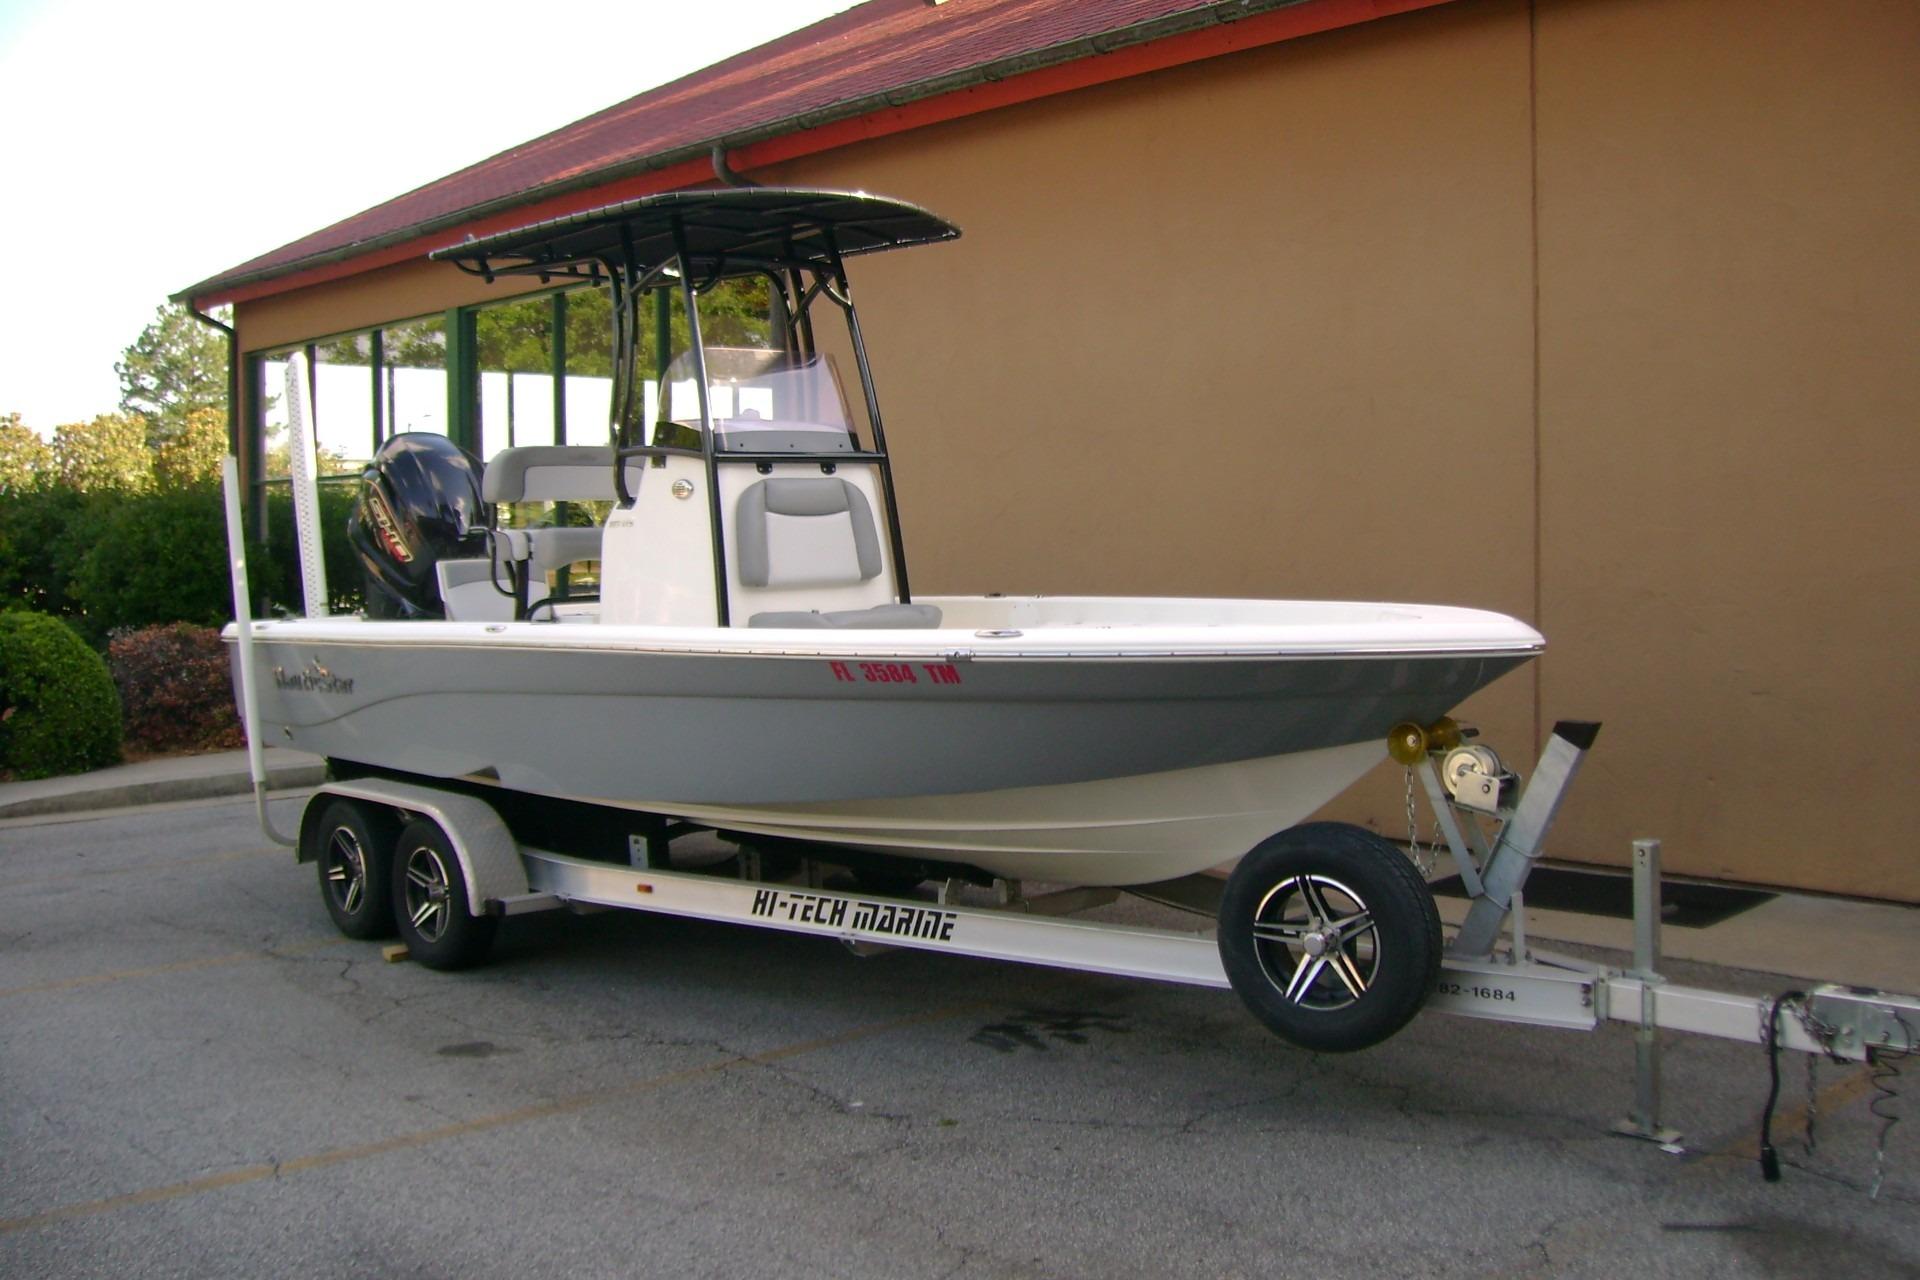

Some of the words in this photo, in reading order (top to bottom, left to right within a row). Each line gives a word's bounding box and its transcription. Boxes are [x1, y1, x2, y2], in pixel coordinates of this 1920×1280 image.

[830, 660, 856, 682] FL
[859, 662, 917, 684] 3584
[922, 663, 962, 684] TM
[752, 889, 848, 927] HI-TECH
[852, 901, 957, 941] MARINE
